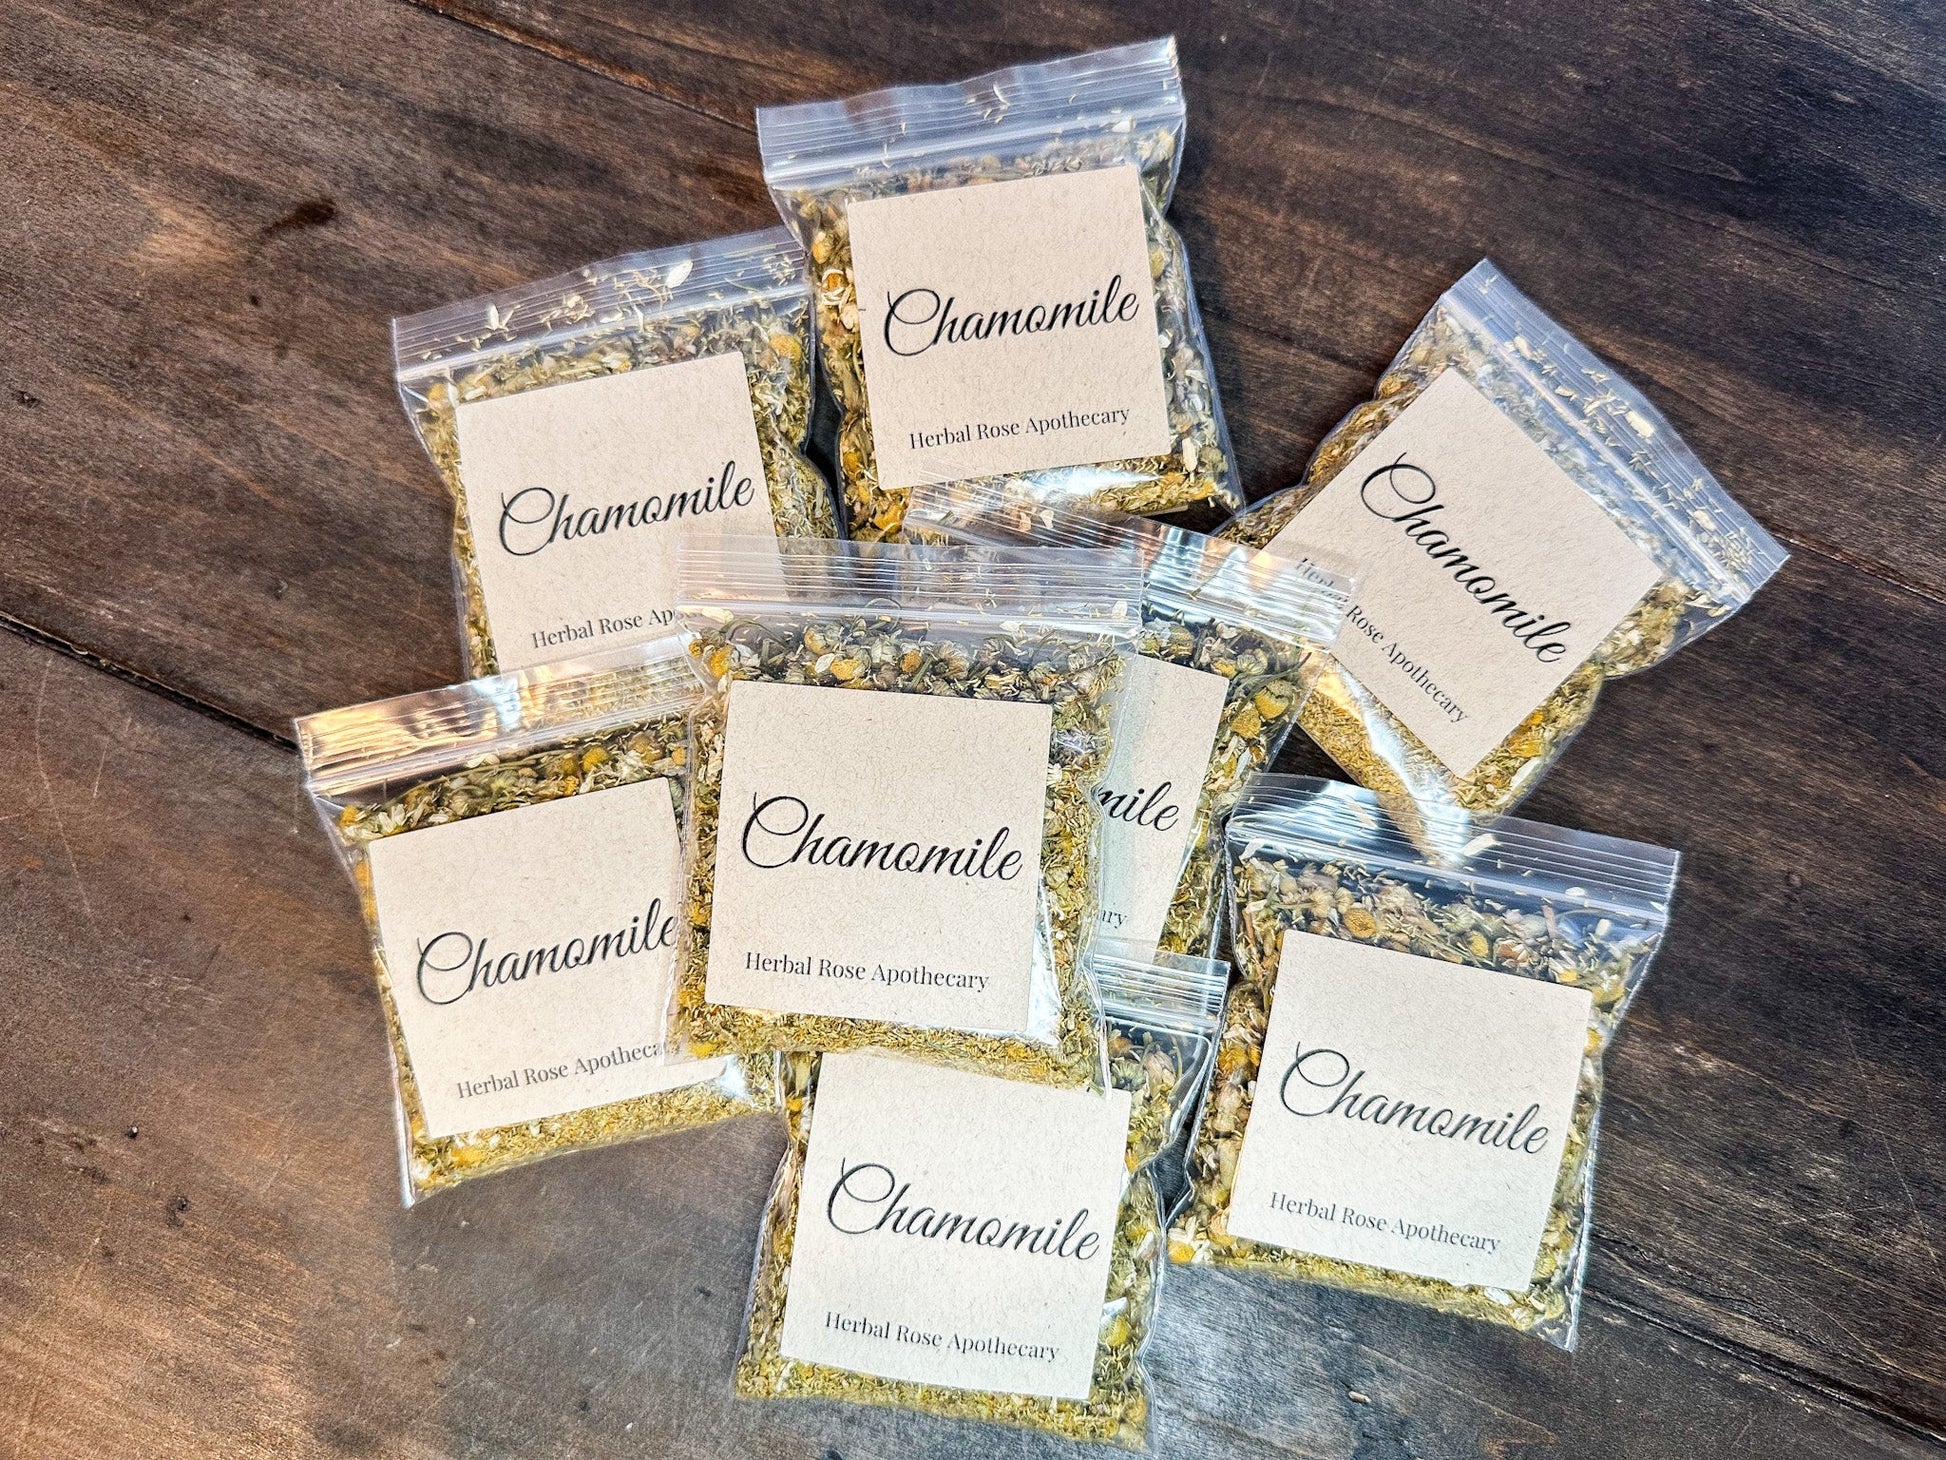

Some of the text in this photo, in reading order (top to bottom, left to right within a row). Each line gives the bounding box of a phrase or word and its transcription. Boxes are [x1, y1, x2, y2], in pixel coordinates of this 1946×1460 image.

[883, 275, 1139, 356] Chamomile
[909, 406, 1130, 451] Herbal Rose Apothecary
[500, 460, 754, 556] Chamomile
[1360, 452, 1574, 666] Chamomile
[532, 620, 594, 648] Herbal
[599, 614, 643, 634] Rose
[1346, 605, 1384, 644] Rose
[1382, 643, 1469, 723] Apothecary
[742, 792, 1022, 881] Chamomile
[416, 898, 678, 1005] Chamomile
[745, 952, 990, 992] Herbal Rose Apothecary
[457, 1070, 520, 1099] Herbal
[525, 1063, 570, 1086] Rose
[1279, 1041, 1549, 1154] Chamomile
[827, 1157, 1100, 1260] Chamomile
[1270, 1191, 1501, 1255] Herbal Rose Apothecary
[825, 1311, 1059, 1362] Herbal Rose Apothecary
